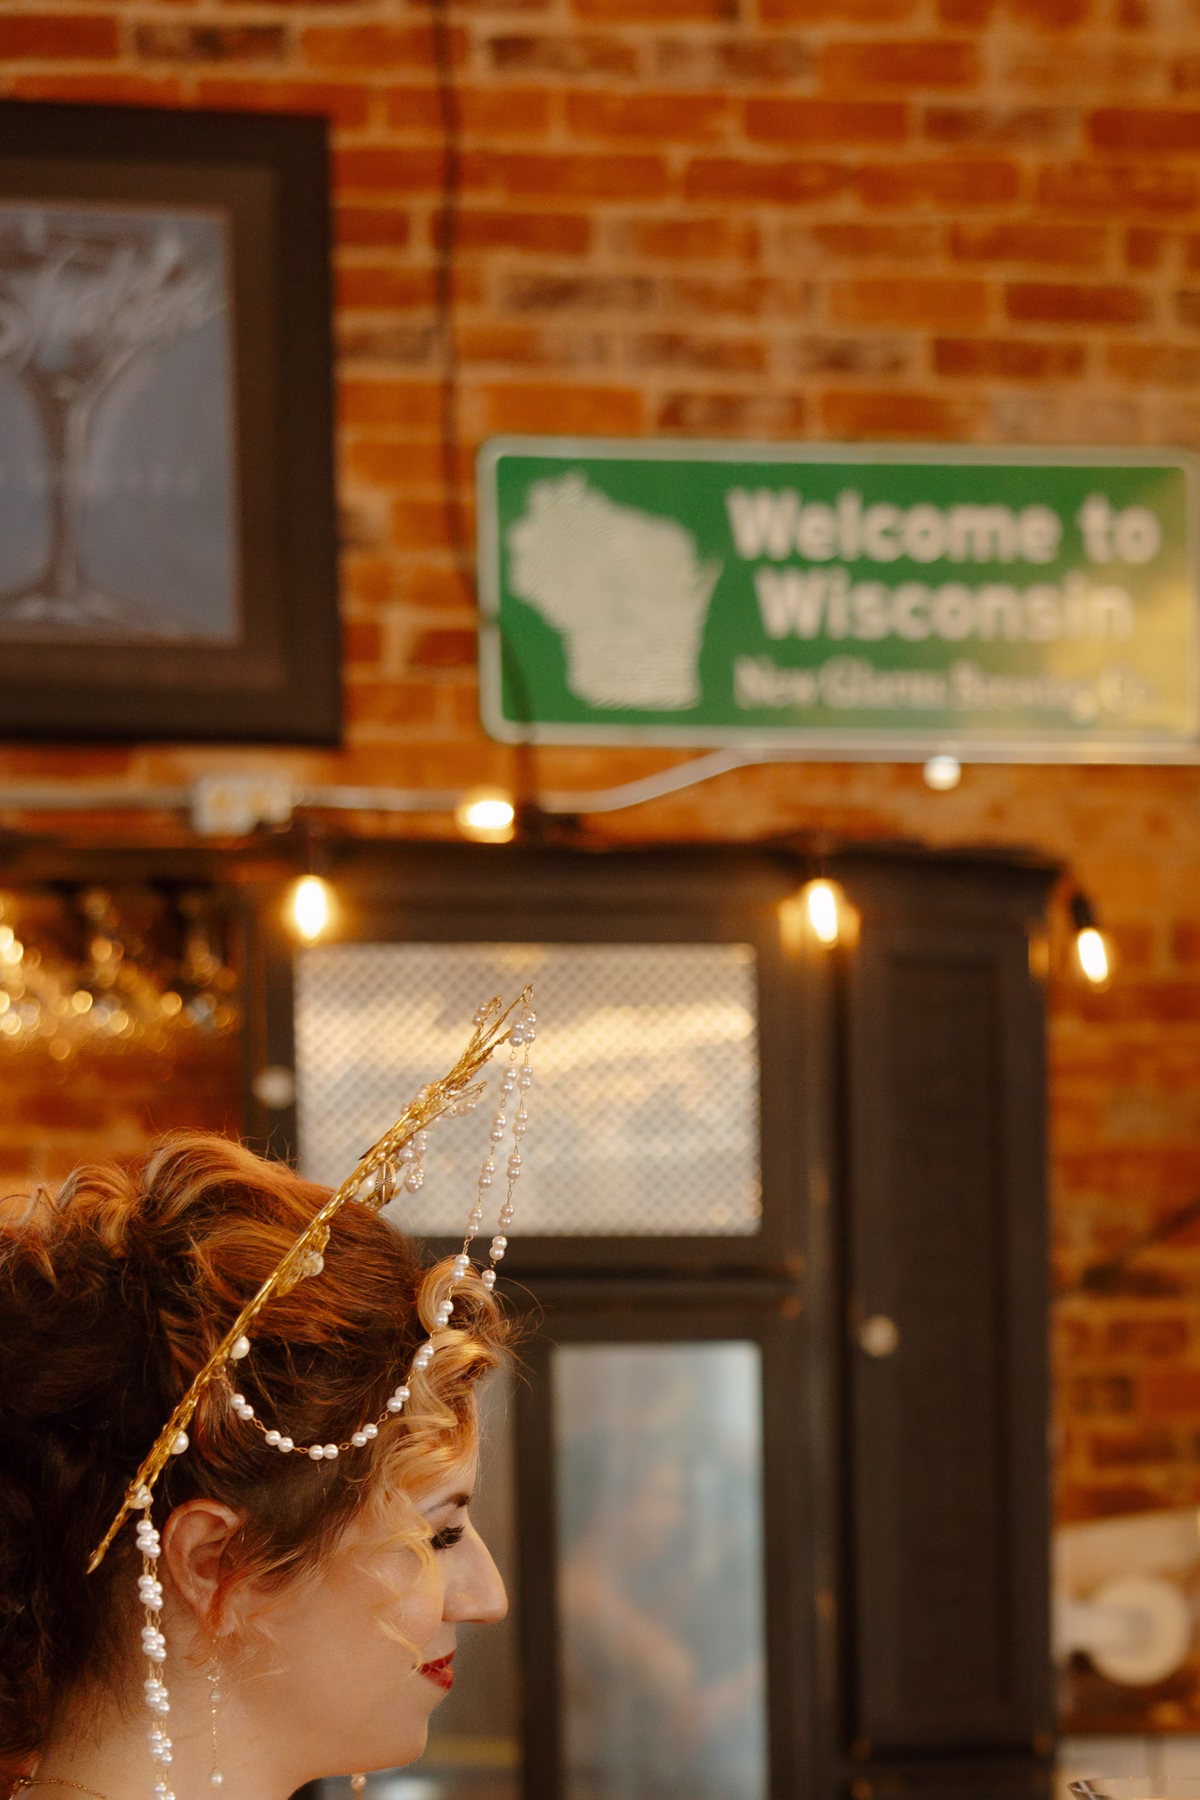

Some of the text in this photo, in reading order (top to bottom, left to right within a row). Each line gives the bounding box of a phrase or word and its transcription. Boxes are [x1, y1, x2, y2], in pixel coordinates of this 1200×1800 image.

[725, 487, 1162, 564] Welcome to
[754, 565, 1135, 641] Wisconsin
